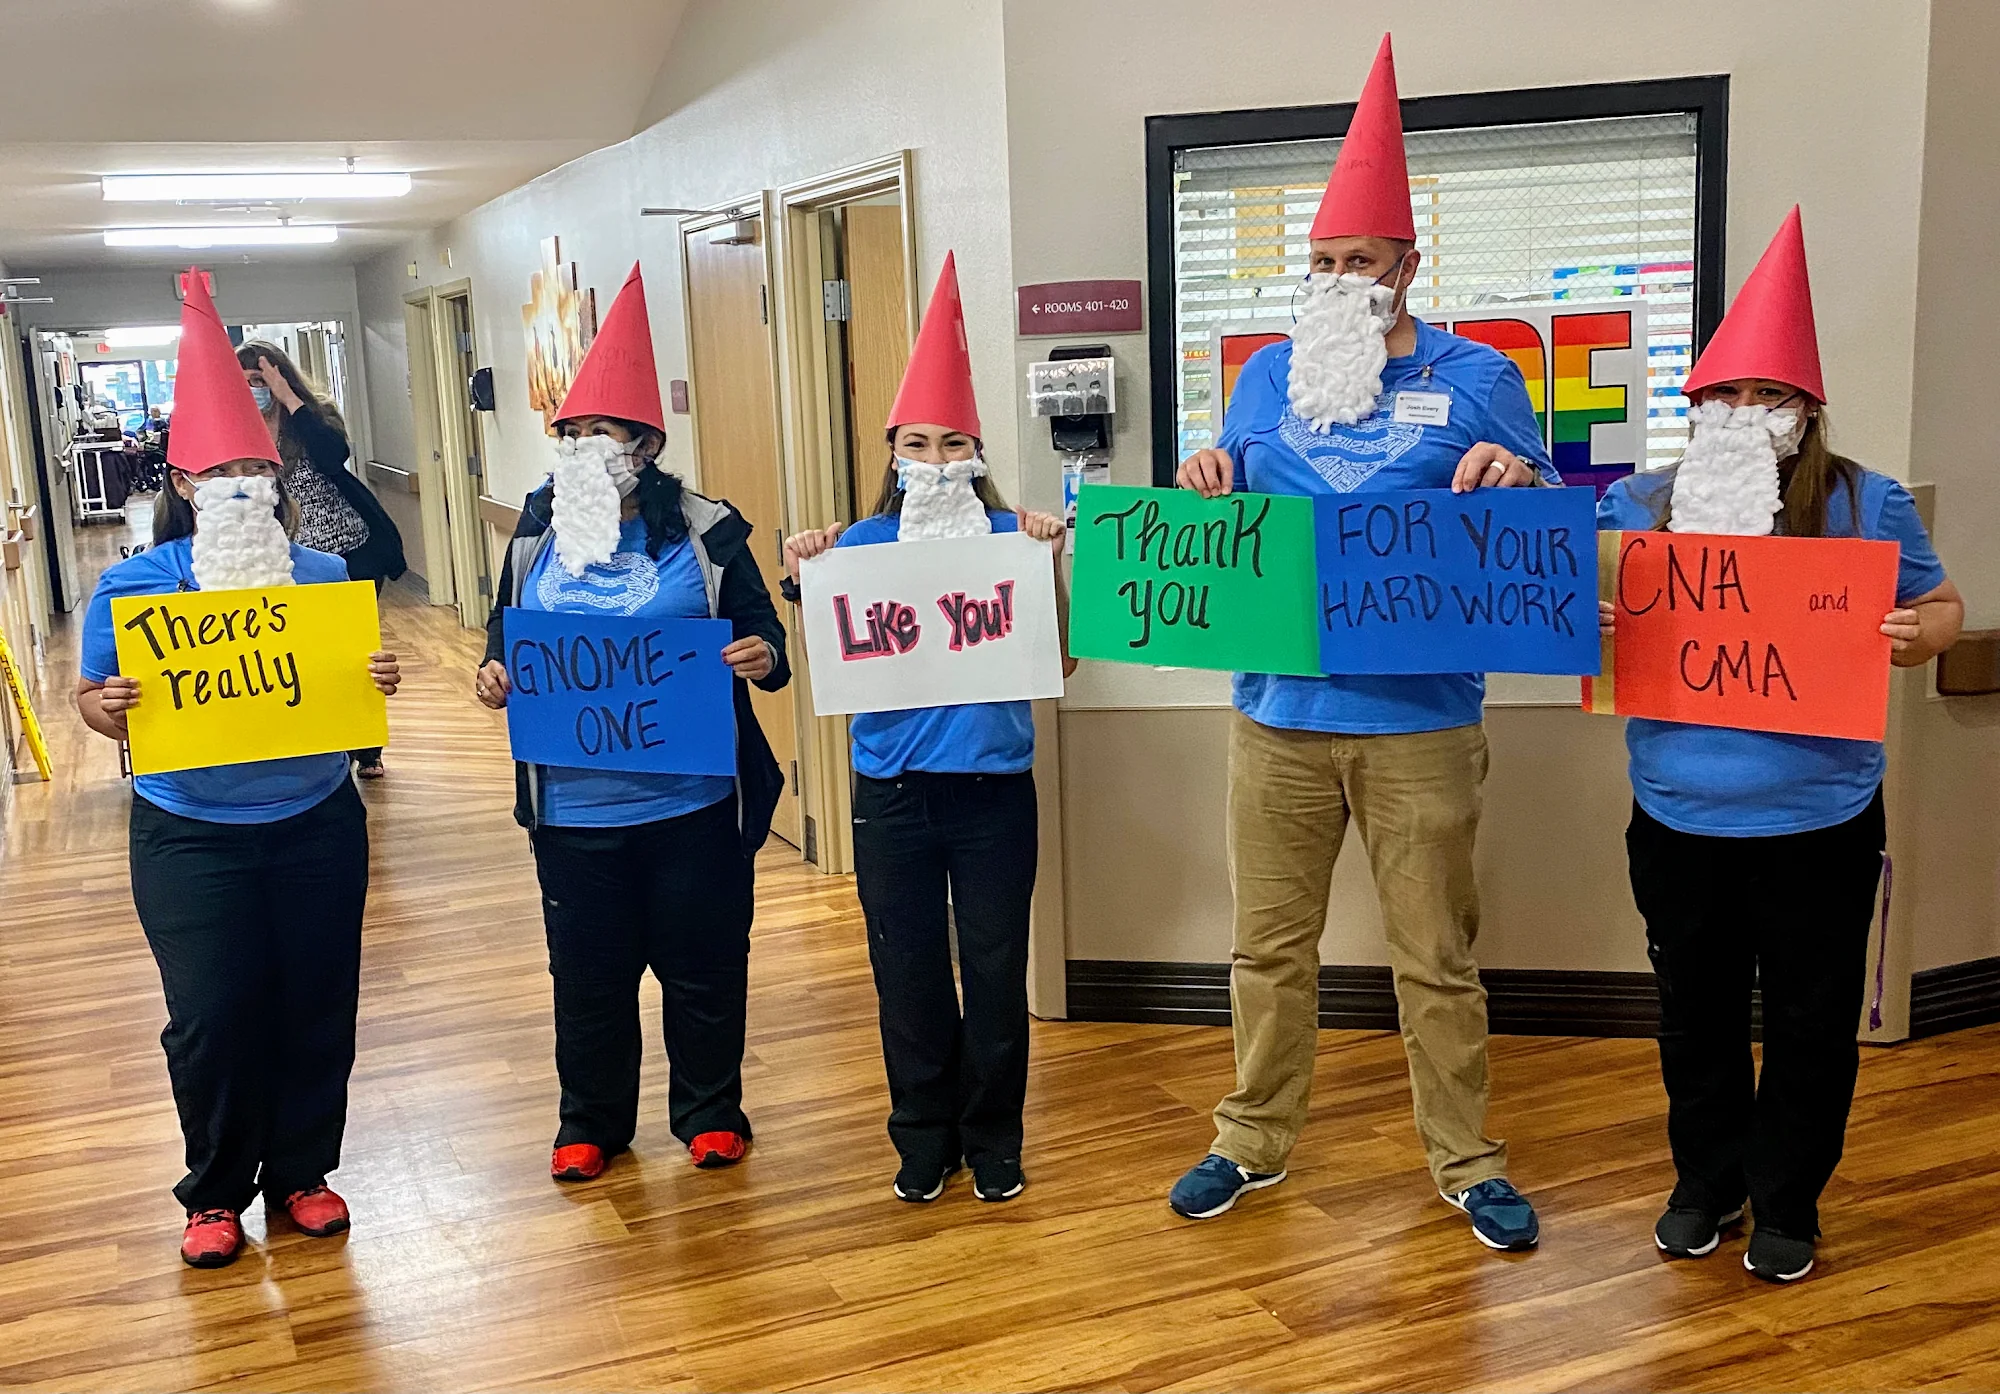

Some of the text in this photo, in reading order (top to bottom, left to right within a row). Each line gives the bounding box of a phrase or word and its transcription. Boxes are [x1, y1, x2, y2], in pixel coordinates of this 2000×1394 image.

[1044, 299, 1129, 314] ROOMS 401-420
[1339, 501, 1578, 579] FOR YOUR
[1324, 574, 1575, 637] HARD WORK
[1618, 537, 1849, 616] CNA and
[124, 596, 288, 661] There's
[937, 580, 1015, 652] You!
[160, 648, 301, 709] really
[1680, 639, 1798, 702] CMA
[576, 698, 666, 756] ONE
